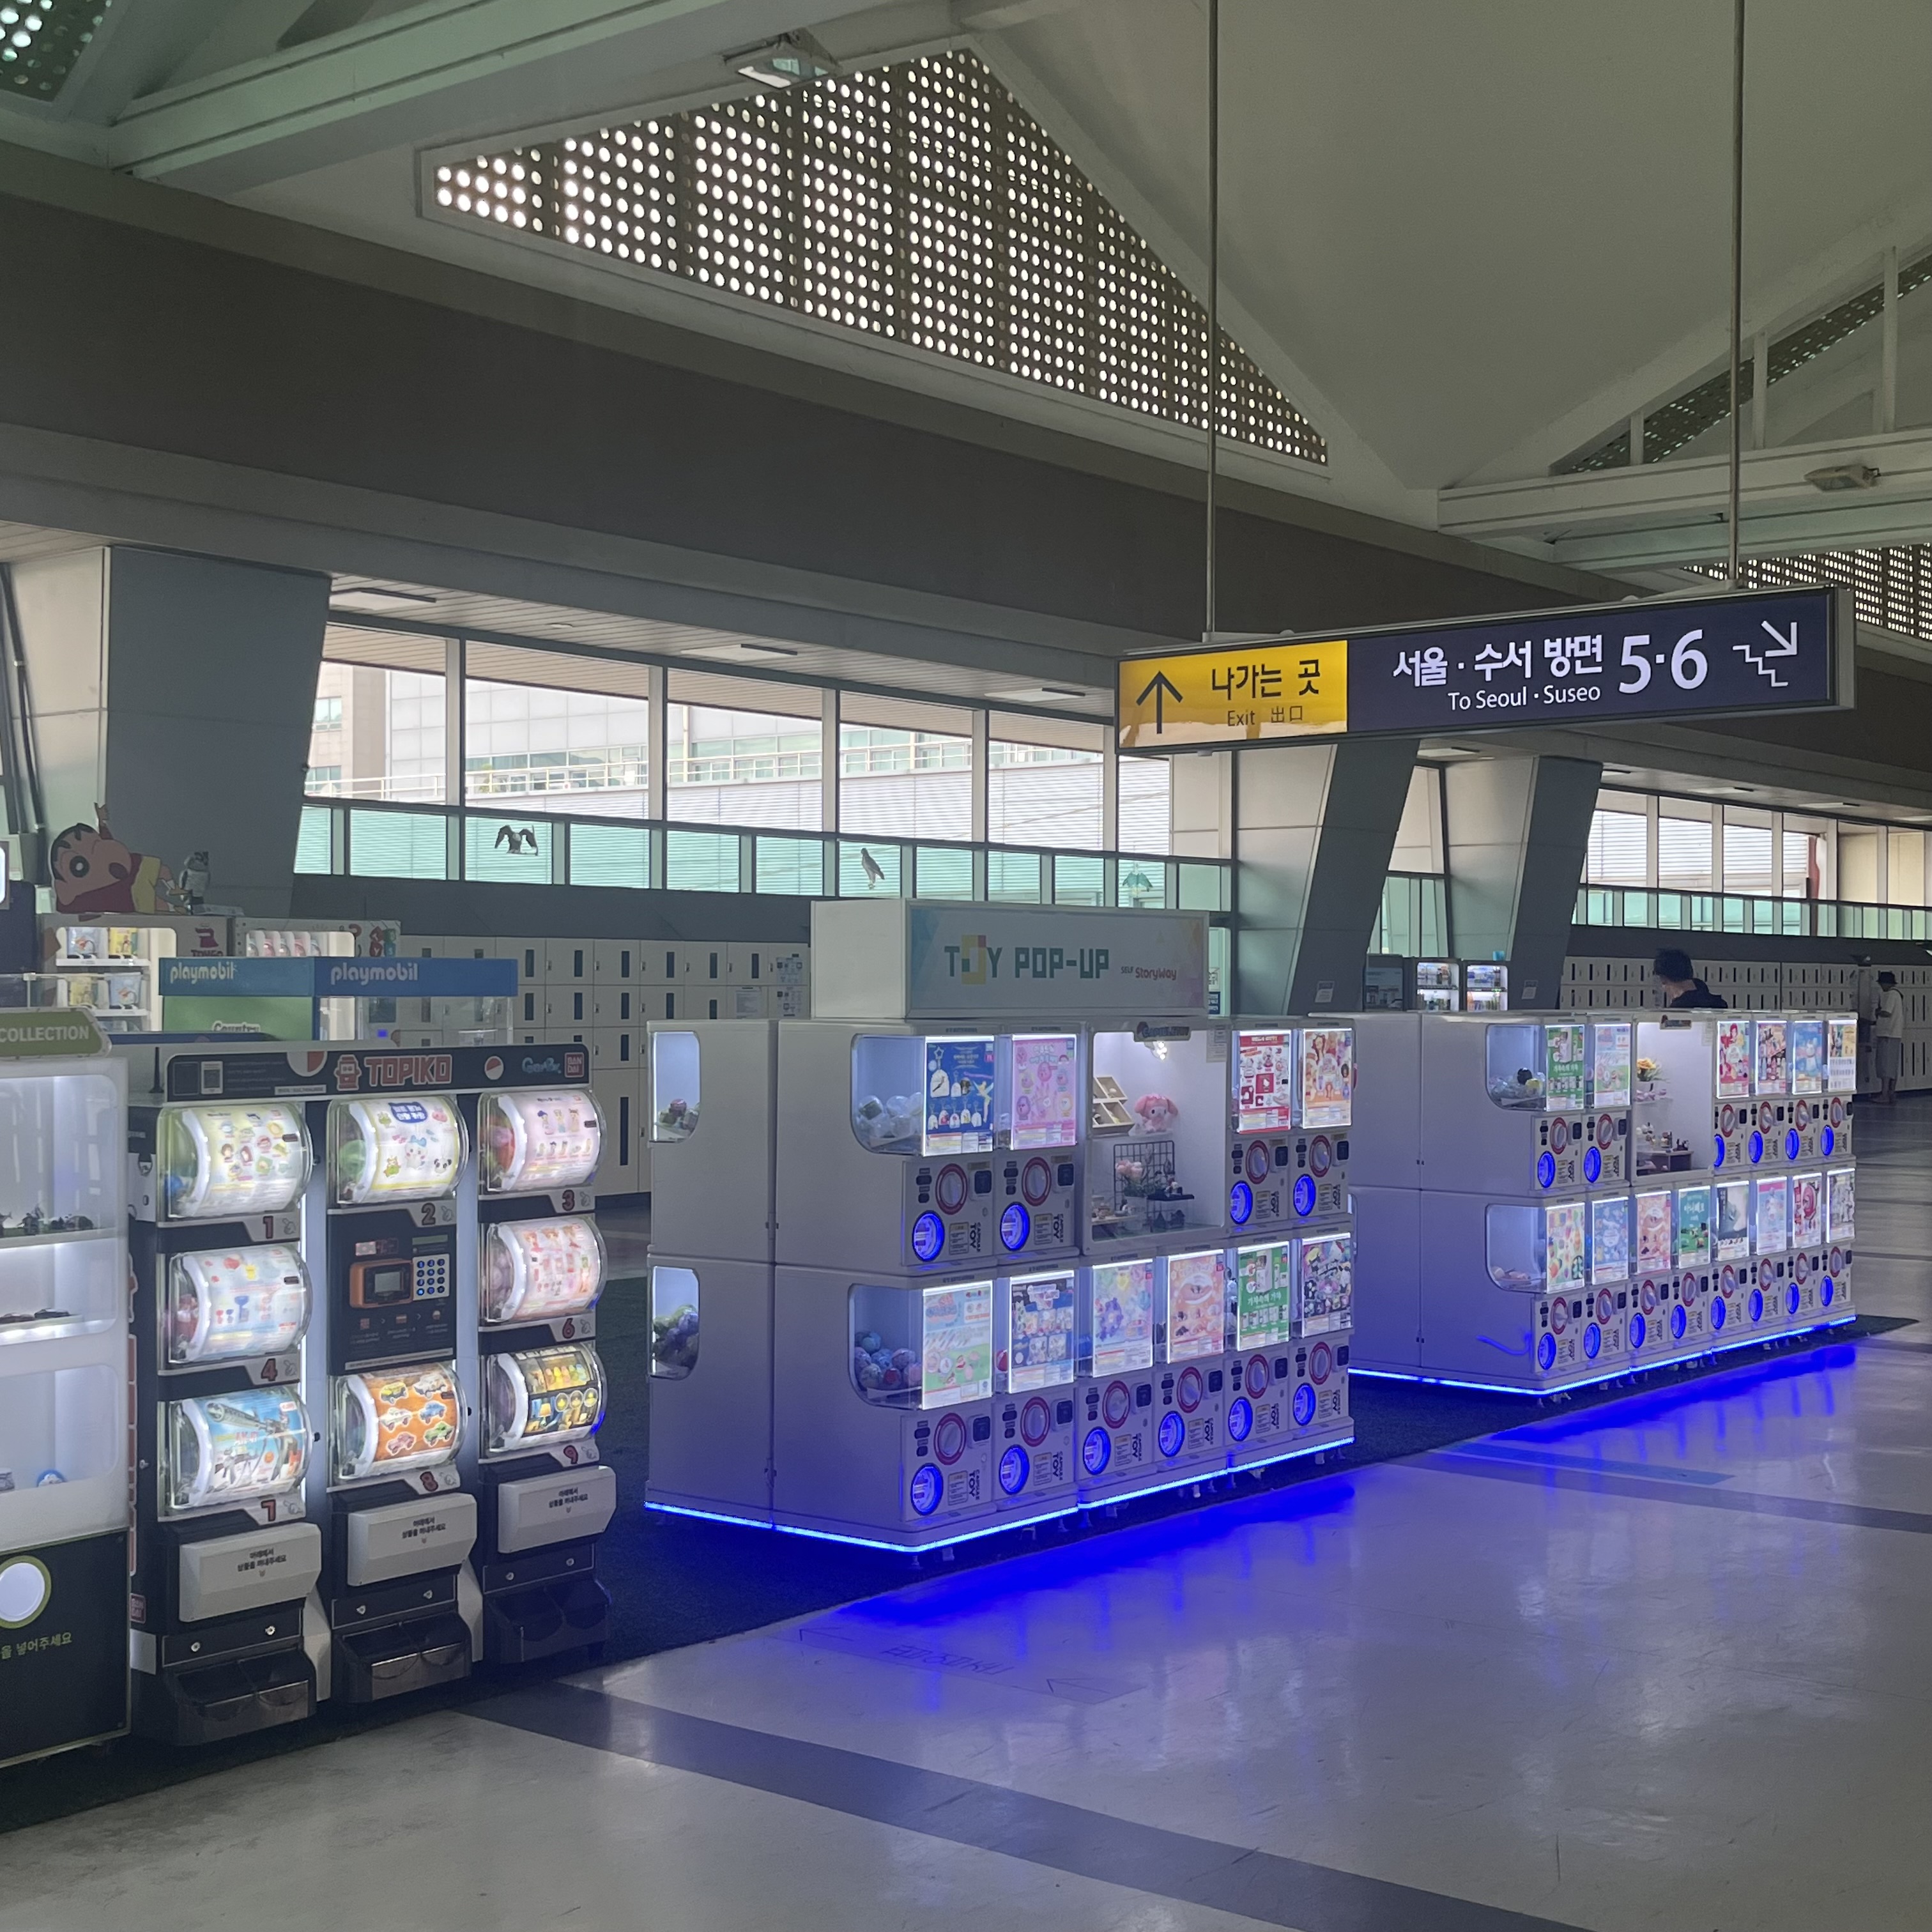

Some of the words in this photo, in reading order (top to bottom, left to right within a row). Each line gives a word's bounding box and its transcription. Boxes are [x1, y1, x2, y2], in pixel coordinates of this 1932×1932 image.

[1393, 647, 1449, 689] 서울
[1475, 640, 1532, 680] 수서
[1544, 634, 1604, 678] 방면
[1212, 664, 1282, 698] 나가는
[1298, 660, 1322, 696] 곳
[1448, 690, 1471, 710] To
[1476, 686, 1528, 709] Seoul
[1544, 683, 1602, 705] Suseo
[1227, 709, 1256, 727] Exit
[1270, 704, 1304, 724] 出口
[170, 961, 235, 984] playmobil
[330, 963, 418, 985] playmobil
[1015, 947, 1109, 979] POP-UP
[365, 1055, 452, 1086] TOPIKO
[562, 1190, 574, 1211] 3
[421, 1203, 436, 1225] 2
[263, 1216, 273, 1239] 1
[562, 1318, 575, 1338] 6
[261, 1358, 277, 1381] 4
[564, 1445, 578, 1464] 9
[420, 1471, 438, 1491] 8
[261, 1499, 276, 1521] 7
[17, 1631, 72, 1655] 넣어주세요
